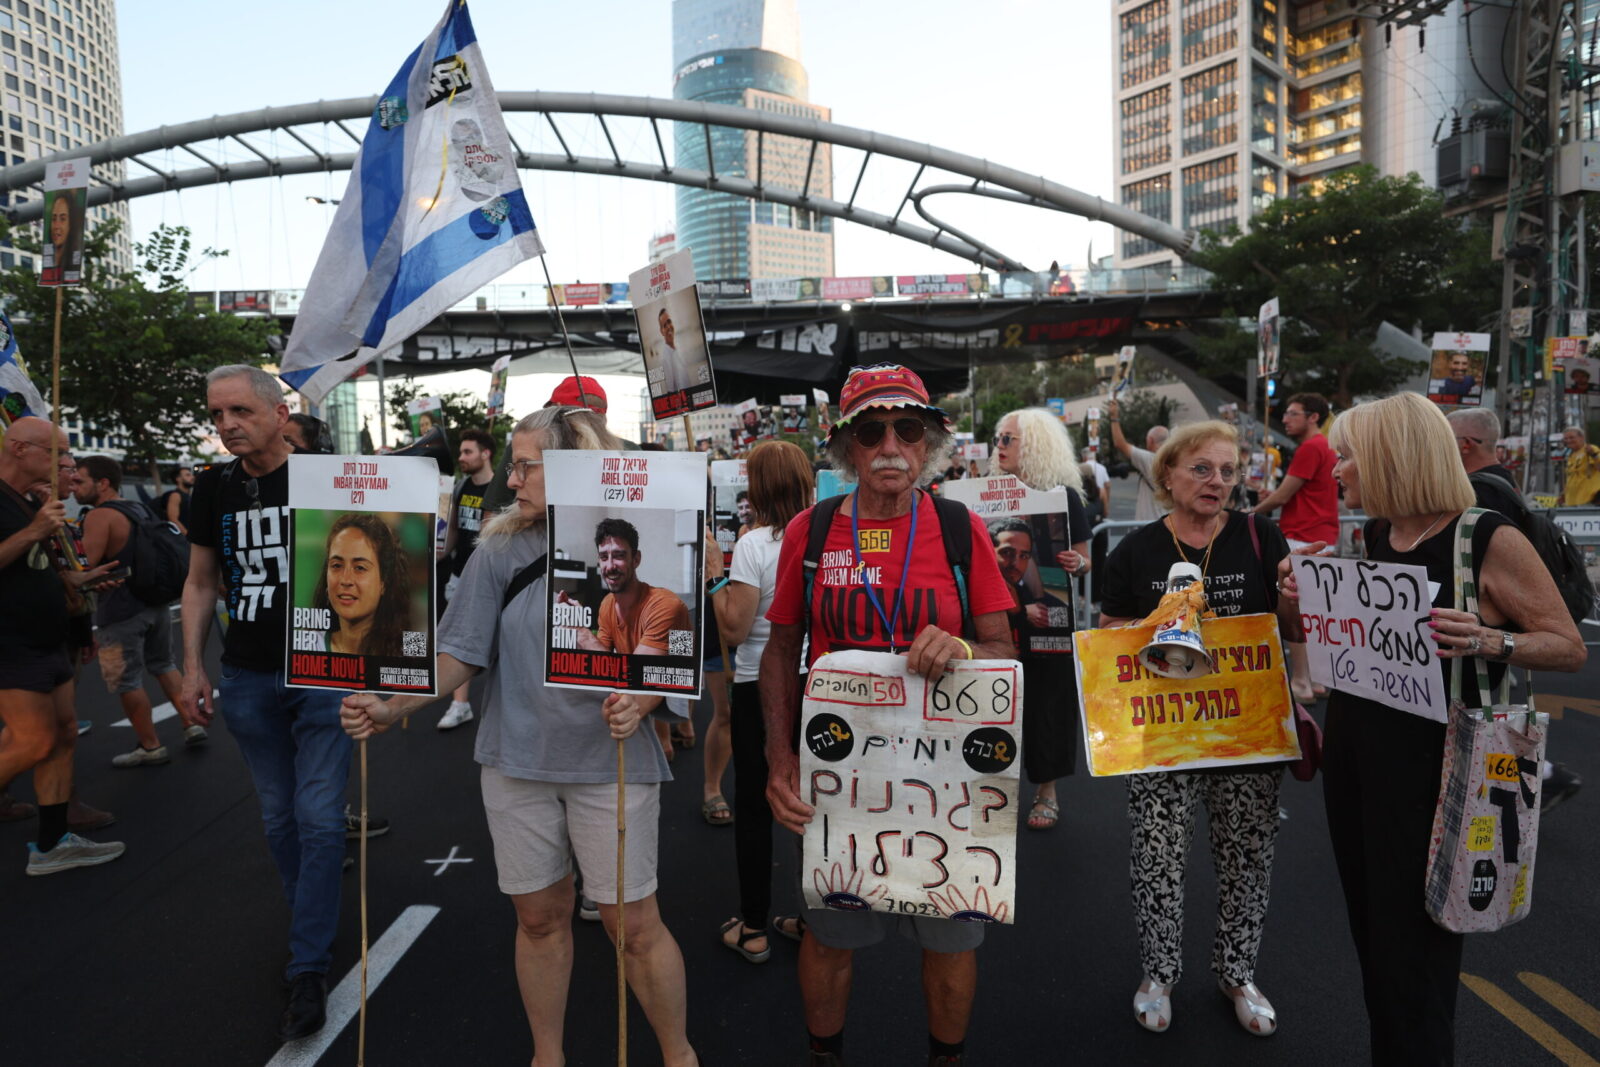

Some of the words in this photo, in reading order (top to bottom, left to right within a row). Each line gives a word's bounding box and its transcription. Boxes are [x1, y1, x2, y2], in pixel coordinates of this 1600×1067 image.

[343, 462, 357, 476] הימן
[358, 463, 378, 476] ענבר
[602, 457, 620, 472] קוניו
[622, 458, 648, 472] אריאל
[333, 476, 353, 489] INBAR
[353, 477, 388, 490] HAYMAN
[601, 472, 621, 486] ARIEL
[623, 472, 648, 486] CUNIO
[350, 490, 365, 504] (27)
[604, 487, 625, 502] (27)
[980, 490, 1004, 502] NIMROD
[1005, 488, 1026, 500] COHEN
[822, 550, 852, 569] BRING
[822, 568, 847, 586] THEM
[1301, 560, 1343, 612] יקר
[1356, 561, 1420, 612] הכל
[293, 607, 331, 630] BRING
[552, 605, 592, 628] BRING
[293, 629, 318, 651] HER
[552, 627, 578, 650] HIM
[1369, 616, 1432, 666] למעט
[291, 654, 328, 676] HOME
[330, 656, 365, 680] NOW!
[551, 652, 589, 676] HOME
[591, 654, 629, 679] NOW!
[1330, 648, 1359, 688] שטן
[380, 674, 407, 686] FAMILIES
[408, 676, 429, 687] FORUM
[643, 673, 672, 686] FAMILIES
[672, 675, 694, 687] FORUM
[810, 678, 868, 696] חטופים
[1370, 667, 1432, 708] מעשה
[873, 682, 901, 702] 50
[1130, 688, 1241, 726] מהגיהנום
[862, 735, 951, 761] ימים
